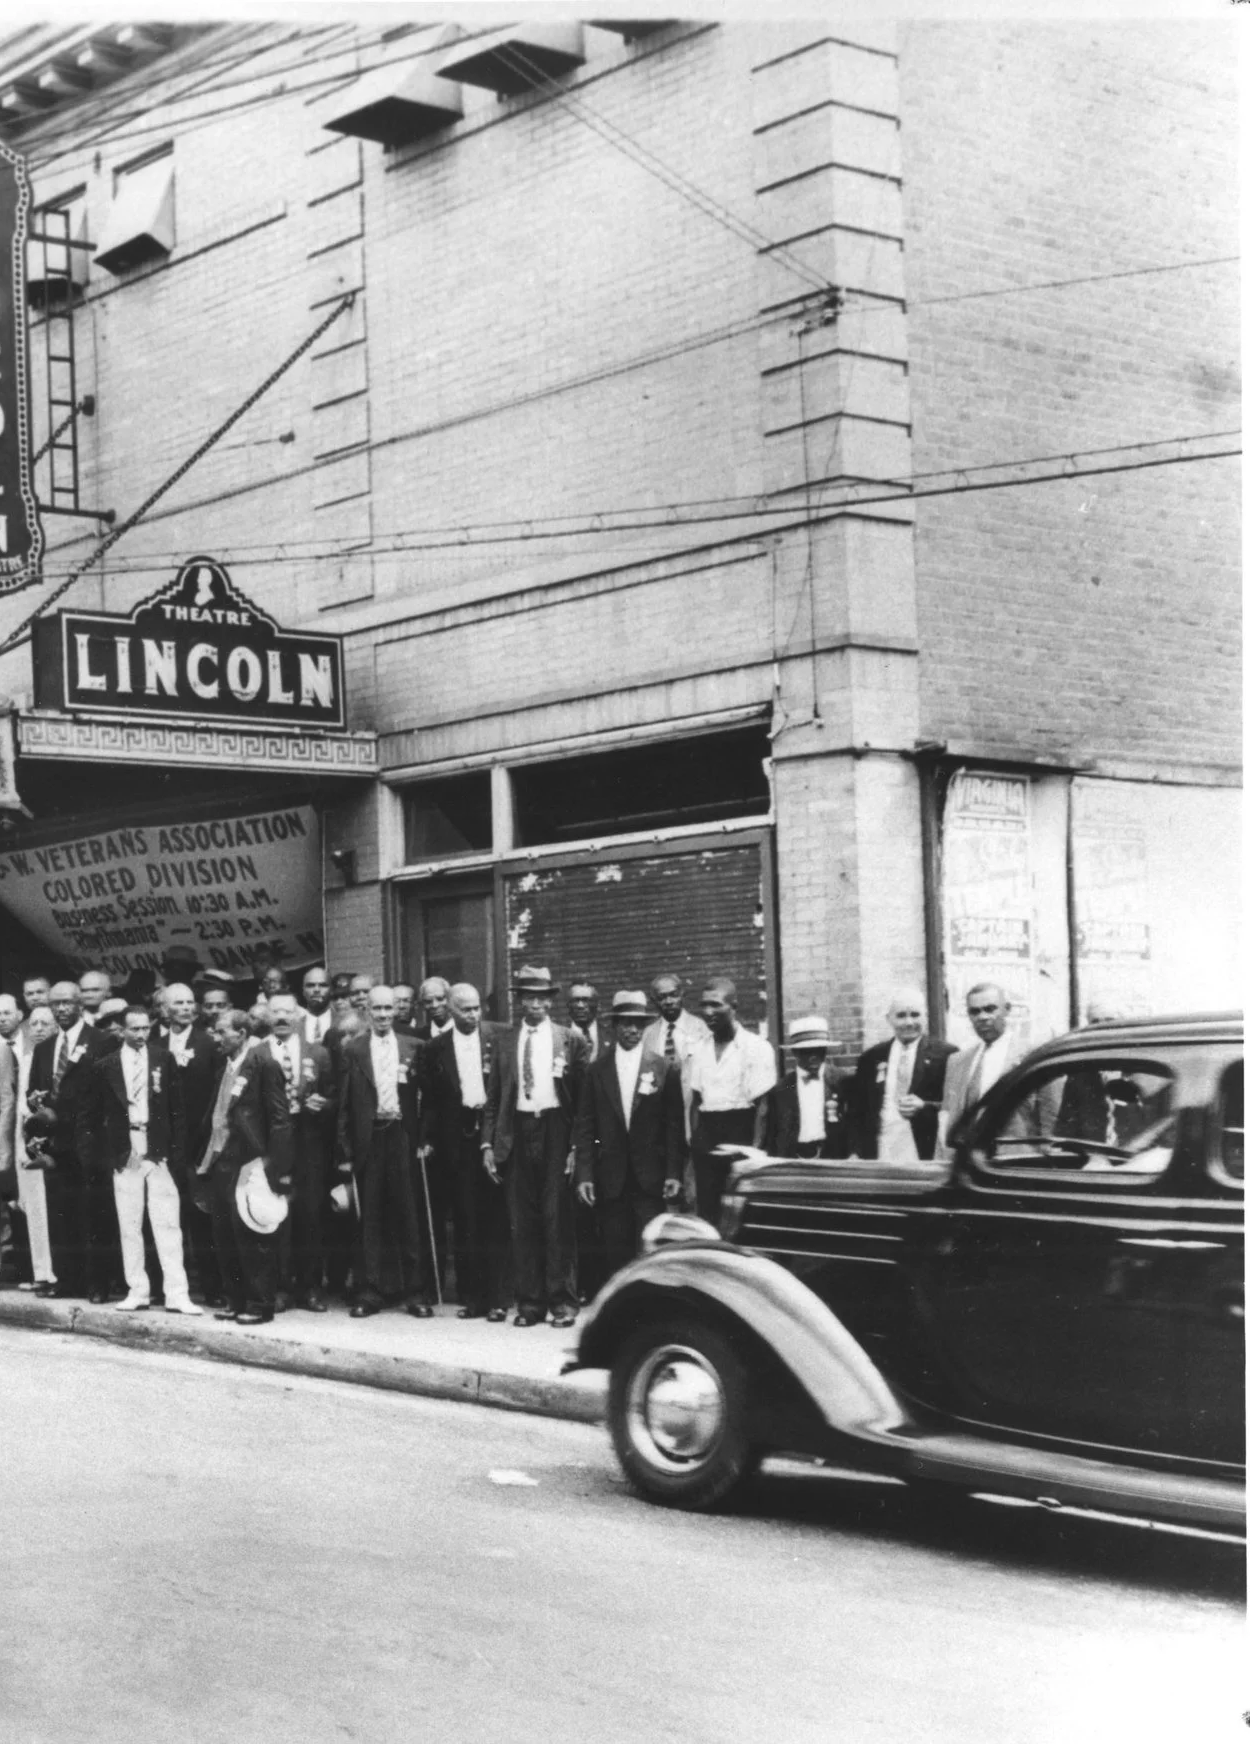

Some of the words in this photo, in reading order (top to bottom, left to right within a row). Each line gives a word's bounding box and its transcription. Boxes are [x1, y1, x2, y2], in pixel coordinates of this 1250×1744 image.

[161, 604, 252, 626] THEATRE
[75, 633, 333, 708] LINCOLN
[9, 852, 35, 877] W.
[34, 828, 148, 873] VETERANS
[158, 811, 306, 853] ASSOCIATION
[42, 867, 137, 904] COLORED
[146, 855, 258, 888] DIVISION
[185, 892, 230, 915] 10:30
[235, 888, 279, 910] A.M.
[195, 919, 235, 940] 2:30
[238, 914, 287, 937] P.M.
